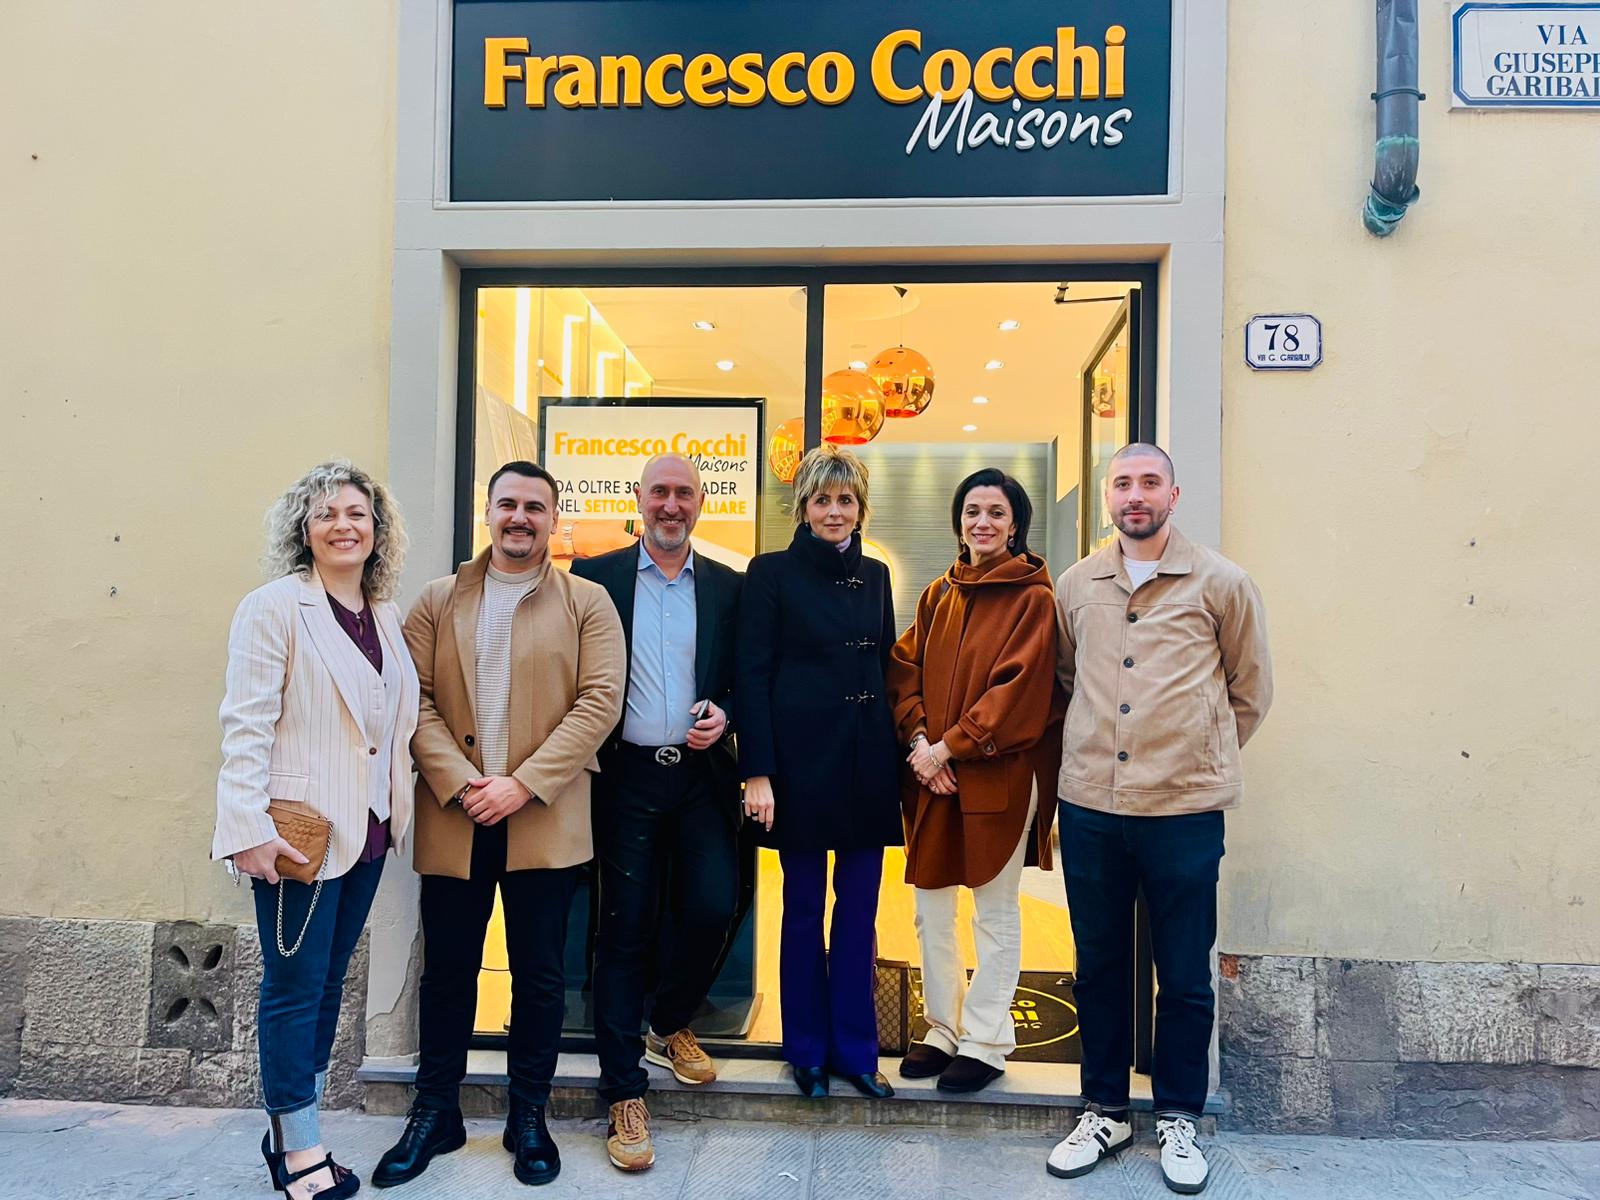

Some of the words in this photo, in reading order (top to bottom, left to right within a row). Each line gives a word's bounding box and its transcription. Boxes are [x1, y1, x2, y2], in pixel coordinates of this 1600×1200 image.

[1536, 24, 1588, 46] VIA
[483, 37, 856, 109] Francesco
[870, 25, 1127, 104] Cocchi
[905, 90, 1133, 155] Maisons
[1264, 323, 1300, 352] 78
[554, 432, 667, 457] Francesco
[671, 431, 747, 457] Cocchi
[689, 452, 748, 473] Maisons
[556, 480, 574, 494] DA
[578, 480, 621, 494] OLTRE
[701, 481, 737, 495] ADER
[584, 500, 637, 513] SETTOR
